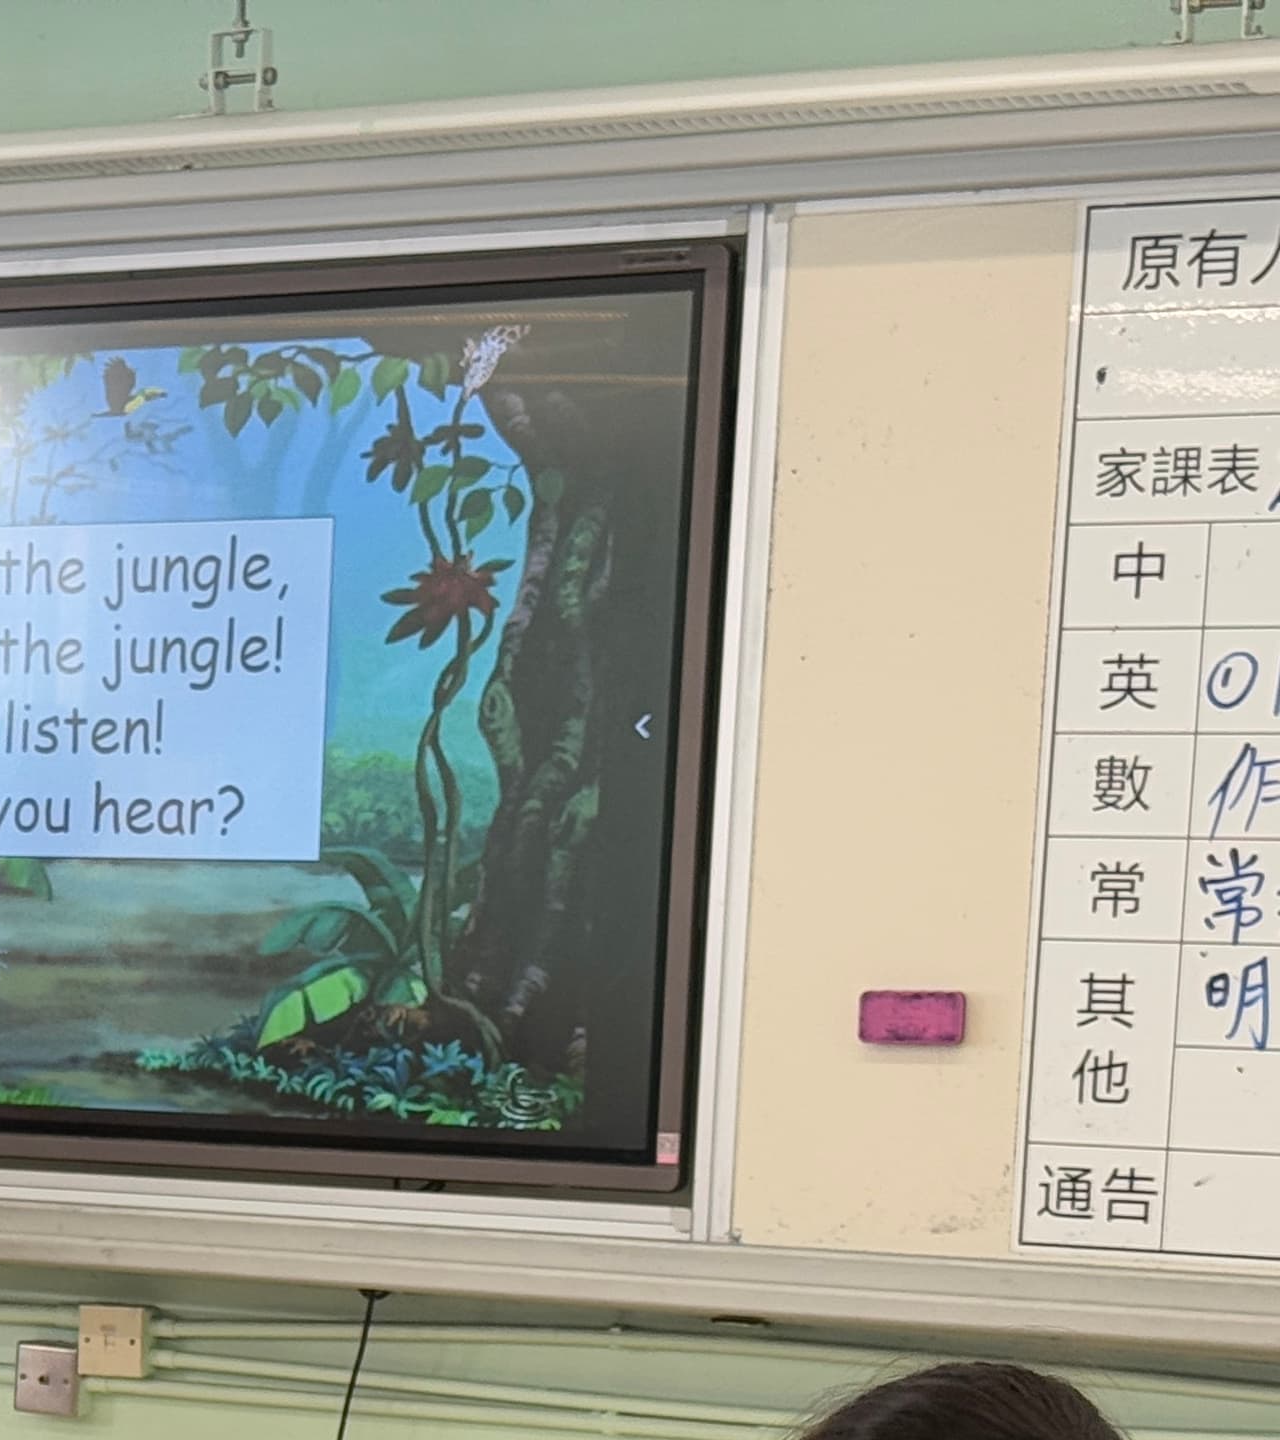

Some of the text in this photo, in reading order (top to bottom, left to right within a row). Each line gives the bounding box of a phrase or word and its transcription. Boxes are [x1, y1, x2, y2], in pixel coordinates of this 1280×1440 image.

[1095, 442, 1260, 499] 家課表
[103, 534, 291, 611] jungle,
[1112, 540, 1166, 599] 中
[102, 616, 285, 692] jungle!
[1099, 652, 1161, 711] 英
[4, 698, 165, 755] listen!
[93, 781, 246, 837] hear?
[1092, 754, 1154, 813] 數
[1090, 861, 1145, 919] 常
[1197, 846, 1280, 946] 常
[1205, 956, 1269, 1052] 明
[1037, 1164, 1159, 1224] 通告
